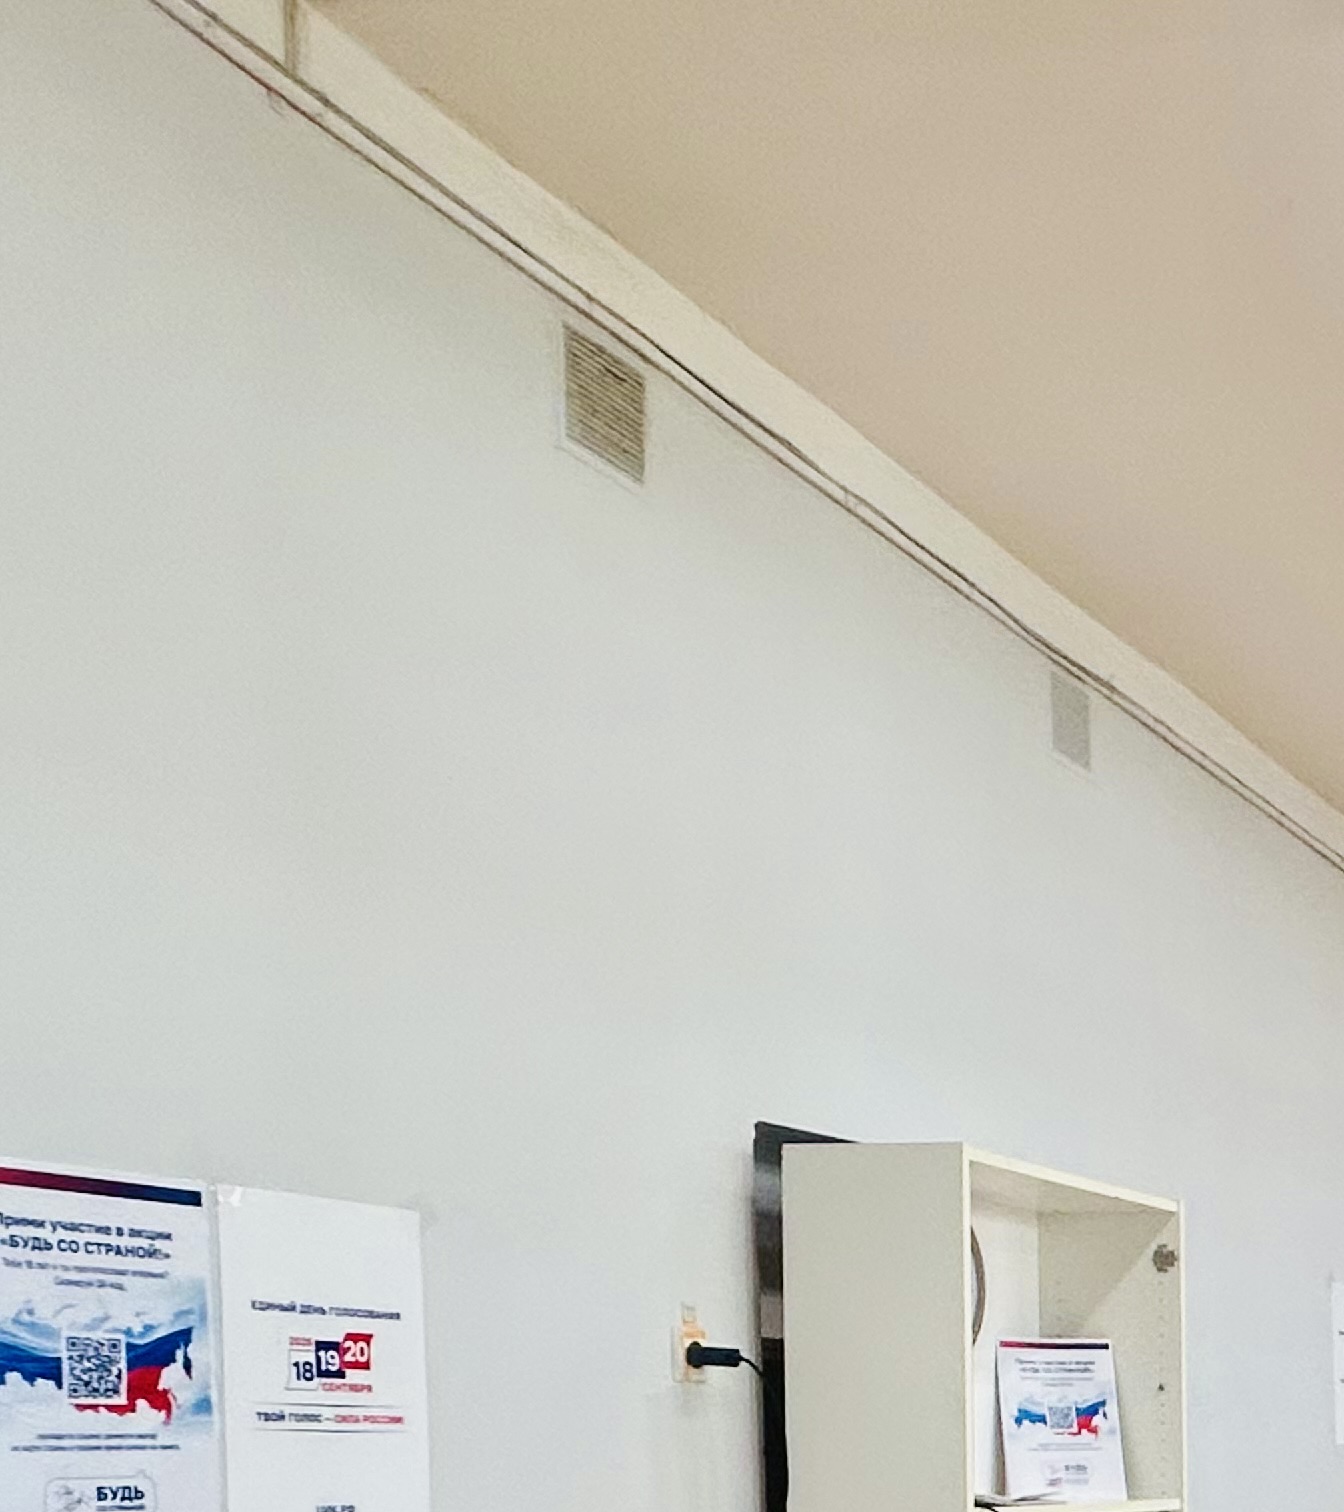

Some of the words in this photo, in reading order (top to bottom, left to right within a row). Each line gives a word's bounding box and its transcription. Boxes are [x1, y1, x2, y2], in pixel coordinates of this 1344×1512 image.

[0, 1211, 46, 1229] рими
[57, 1239, 80, 1253] СО
[292, 1361, 314, 1381] 18
[318, 1350, 340, 1371] 19
[343, 1340, 369, 1362] 20
[97, 1485, 145, 1502] БУДЬ
